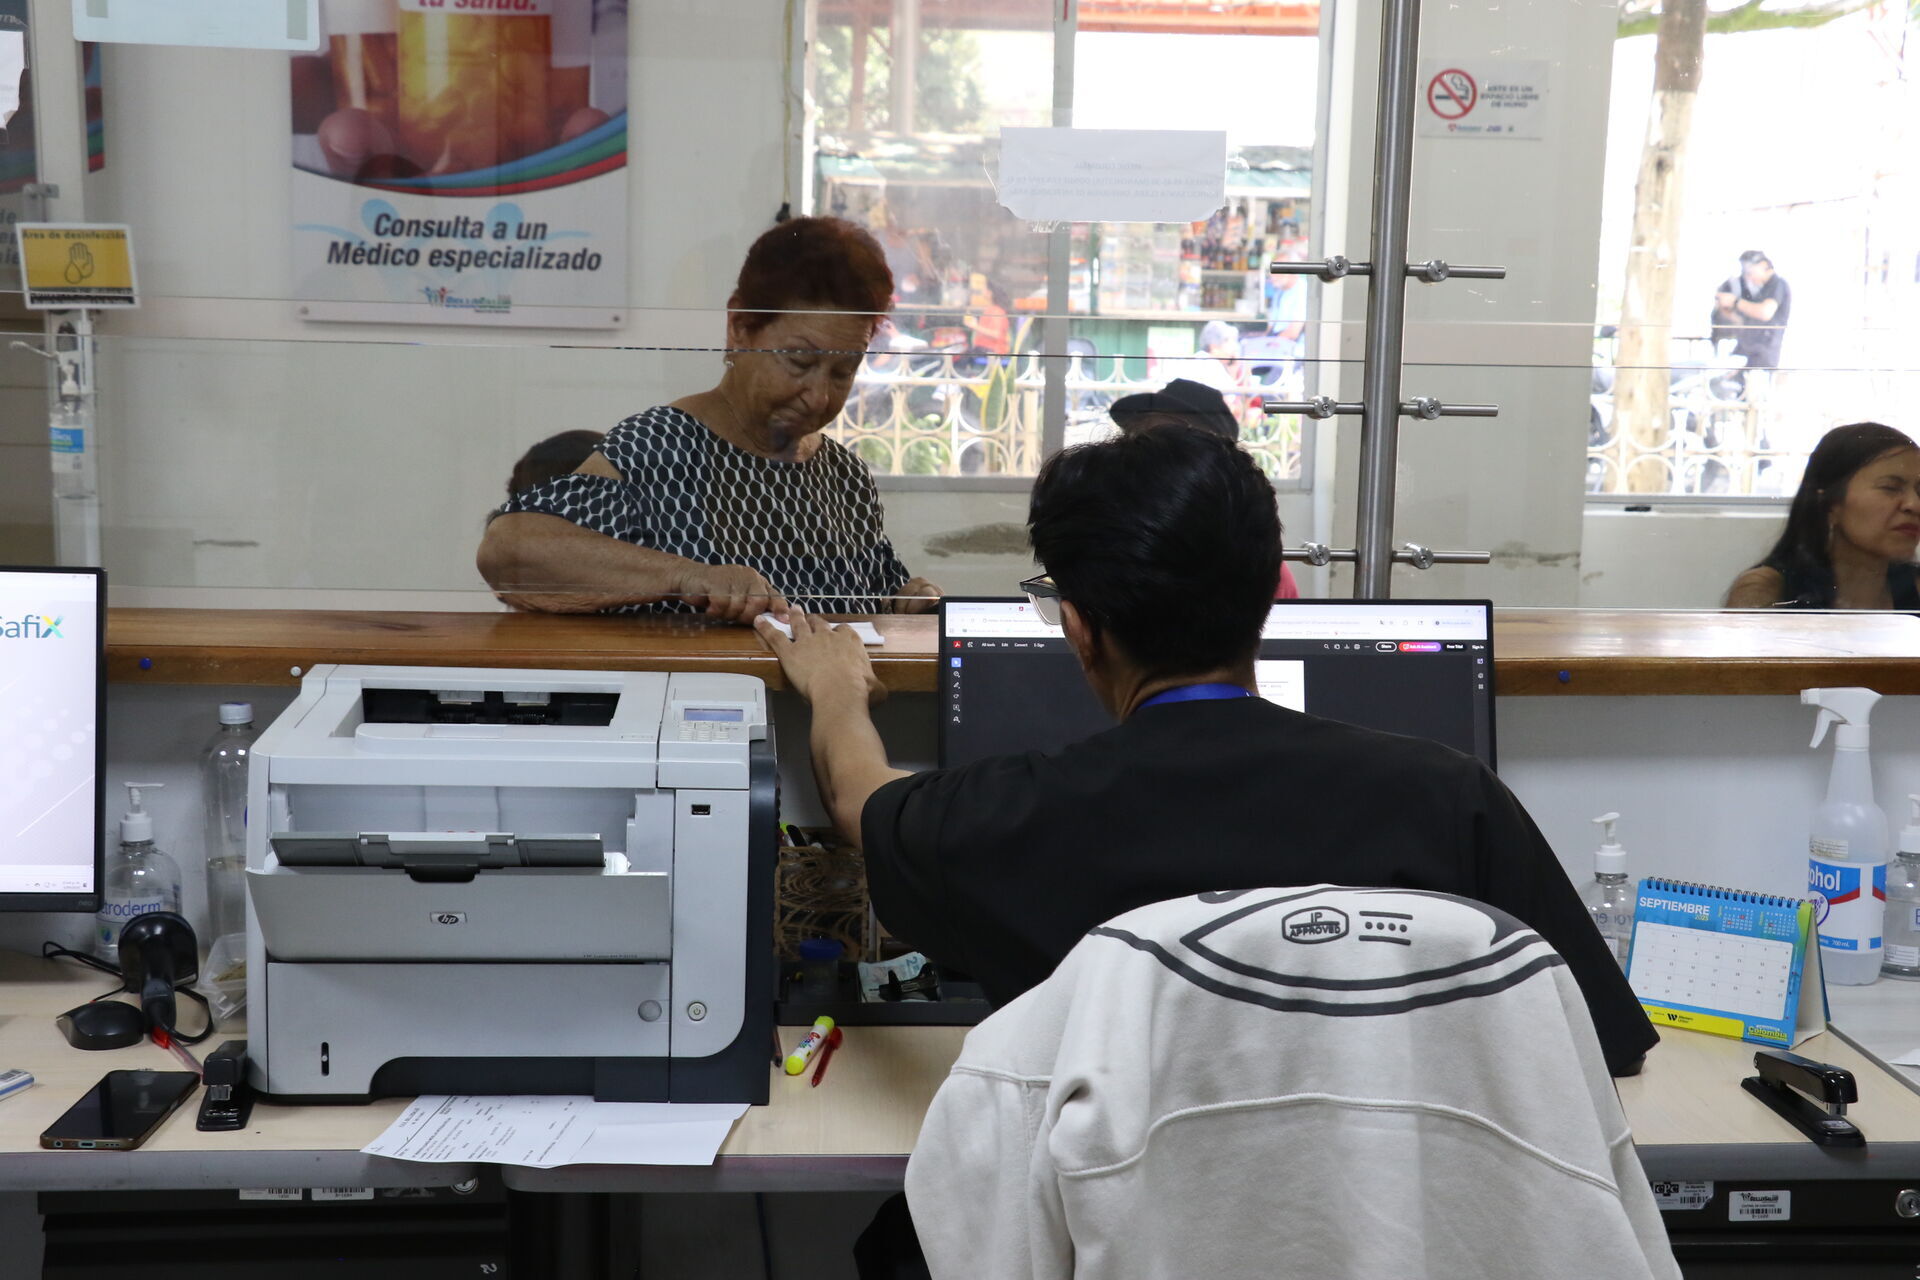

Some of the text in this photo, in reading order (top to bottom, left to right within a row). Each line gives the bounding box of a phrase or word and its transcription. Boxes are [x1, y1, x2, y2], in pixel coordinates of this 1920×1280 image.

[373, 213, 548, 241] Consulta a un
[326, 240, 602, 273] Médico especializado
[1639, 896, 1711, 916] SEPTIEMBRE
[1310, 911, 1323, 923] IP
[1289, 924, 1341, 937] APPROVED
